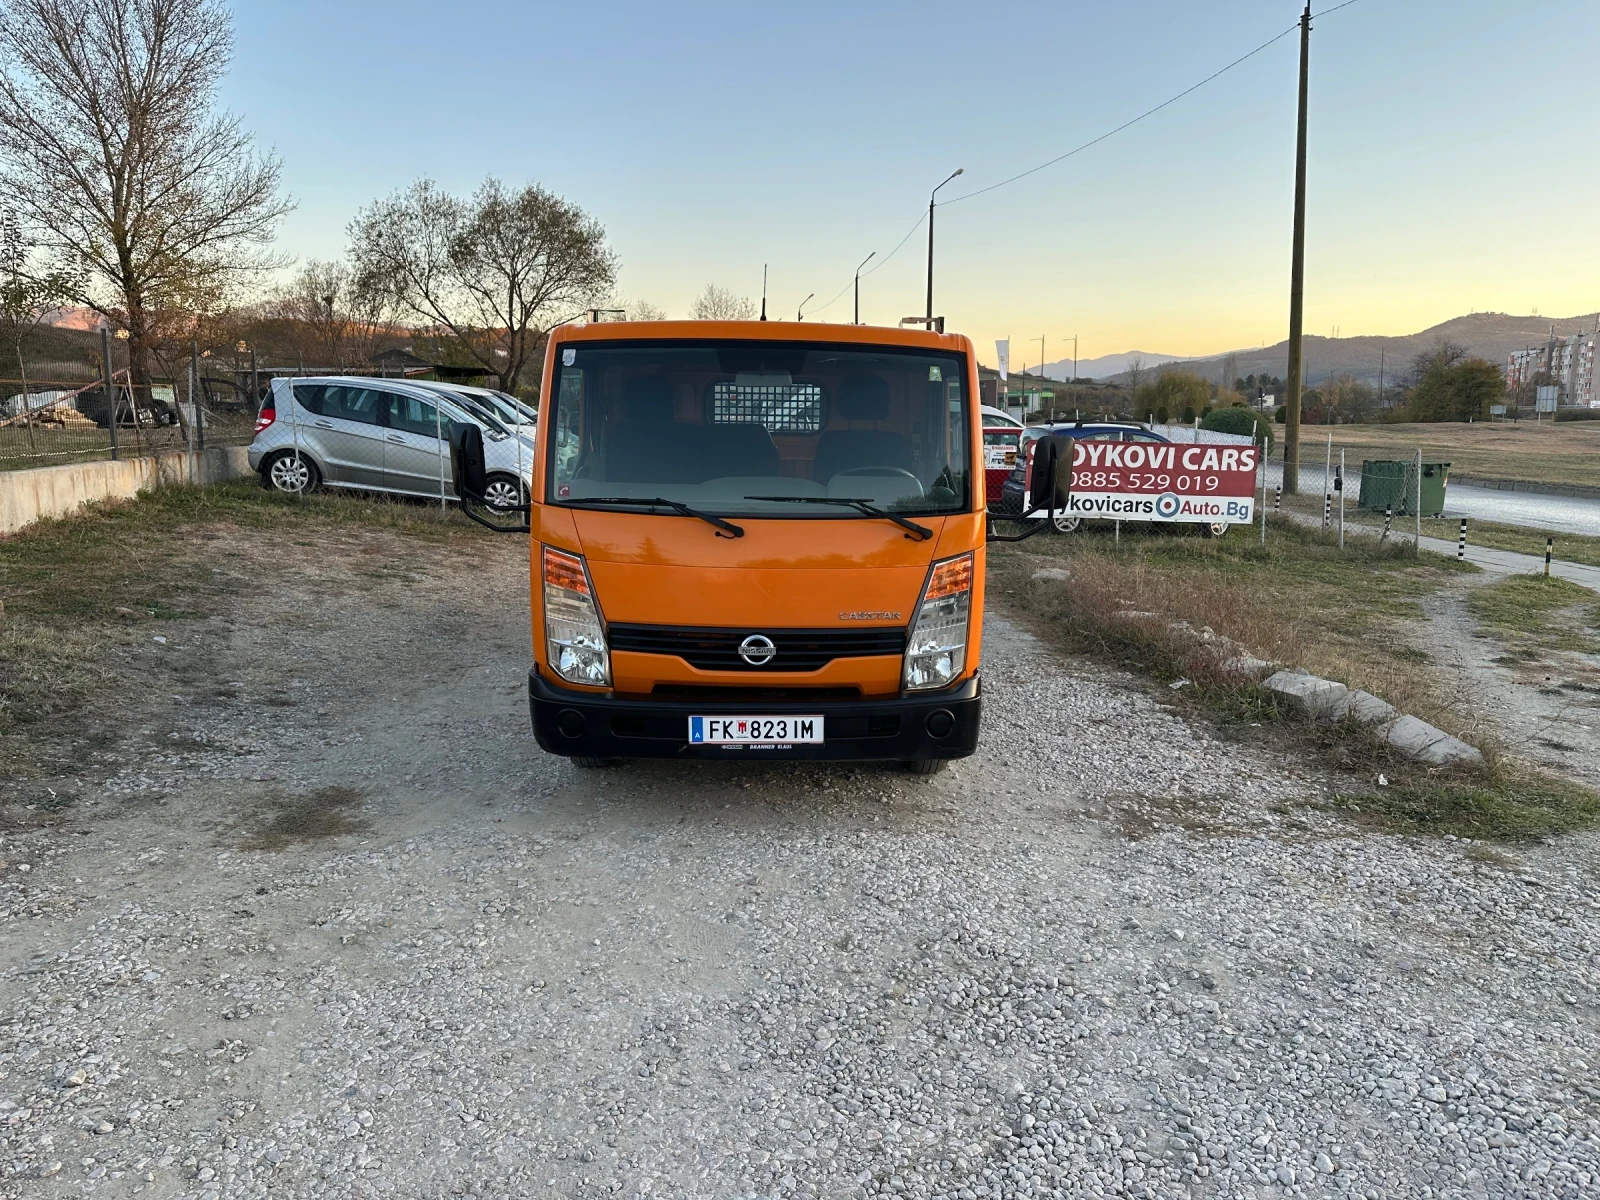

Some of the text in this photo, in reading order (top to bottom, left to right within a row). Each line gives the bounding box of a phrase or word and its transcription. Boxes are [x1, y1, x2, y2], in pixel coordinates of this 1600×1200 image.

[1182, 447, 1255, 472] CARS
[1127, 473, 1171, 489] 529
[1176, 475, 1219, 491] 019
[709, 720, 734, 739] FK
[750, 720, 788, 739] 823
[794, 720, 814, 739] IM
